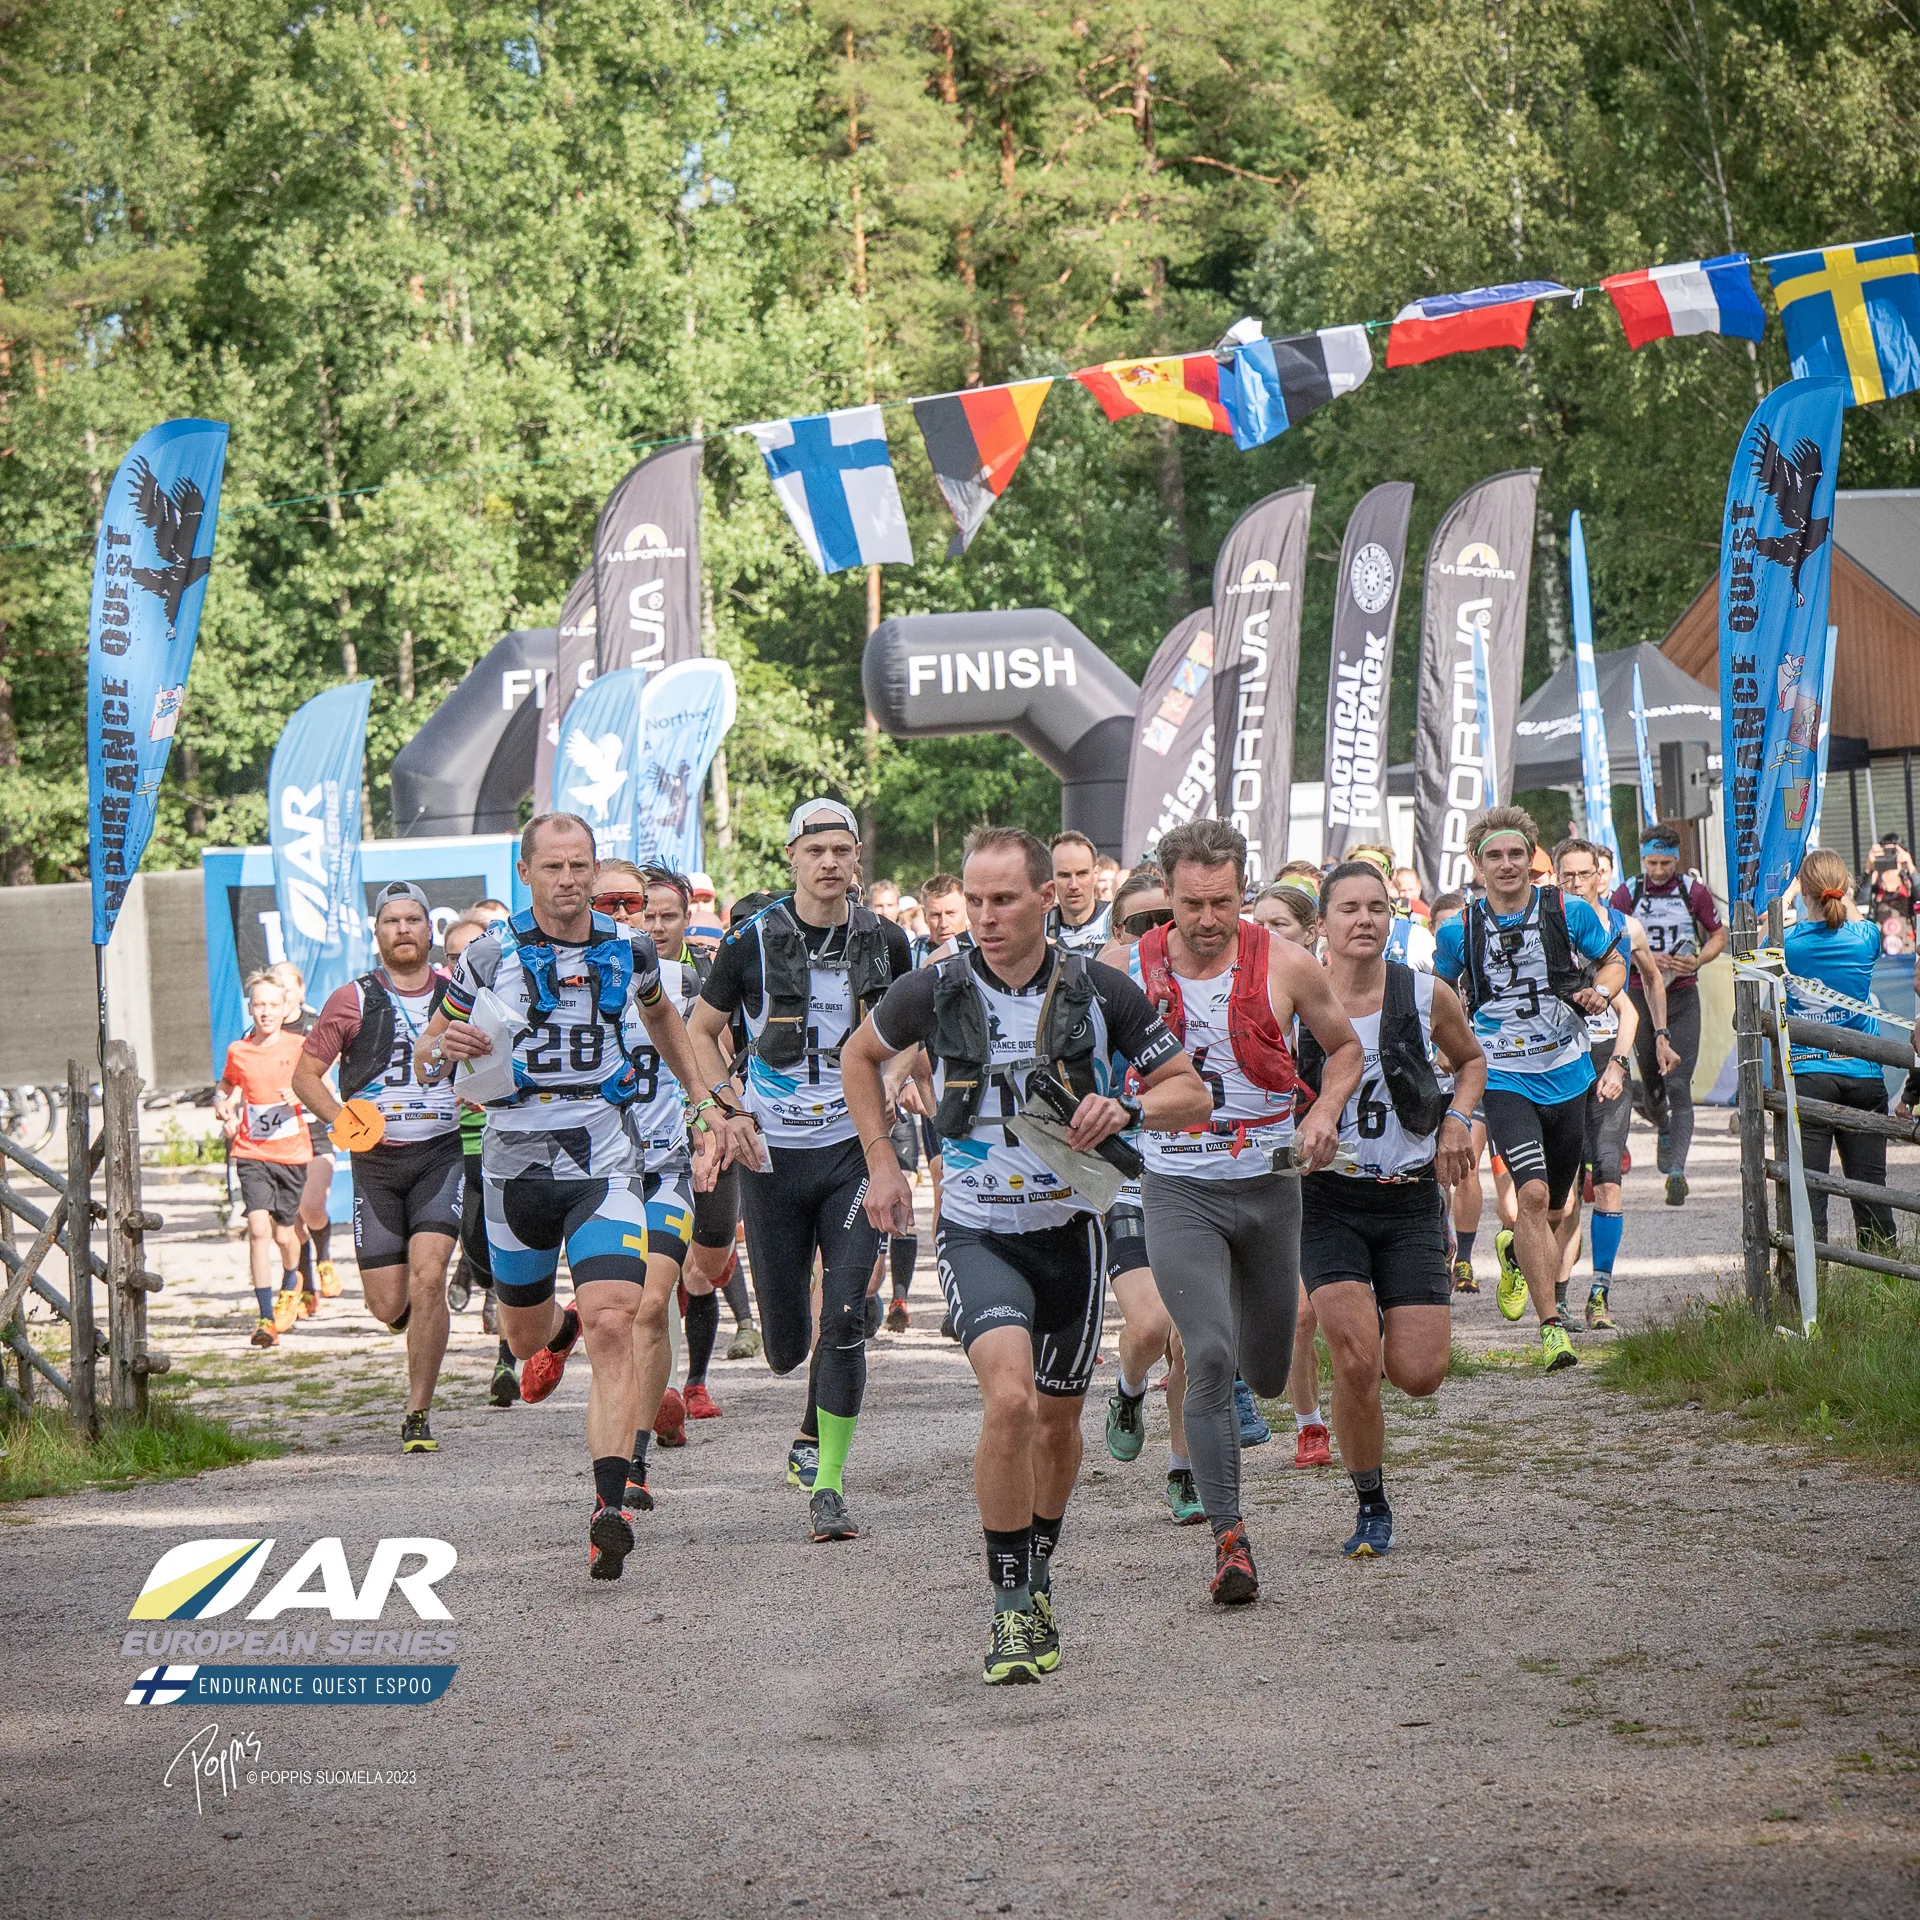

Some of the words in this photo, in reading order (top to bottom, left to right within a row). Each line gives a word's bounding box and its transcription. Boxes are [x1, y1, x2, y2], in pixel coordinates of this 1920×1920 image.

[1728, 500, 1759, 632] QUEST
[100, 525, 132, 657] QUEST
[908, 647, 1078, 696] FINISH
[1328, 659, 1364, 828] TACTICAL
[1350, 631, 1387, 828] FOODPACK
[1731, 653, 1766, 895] NDURANCE
[281, 783, 330, 888] AR
[1648, 926, 1679, 951] 31
[825, 1003, 843, 1011] QUEST
[525, 1023, 605, 1073] 28
[1019, 1040, 1037, 1049] QUES
[1364, 1053, 1380, 1063] UEST
[1792, 1053, 1822, 1061] UMONITE
[259, 1113, 281, 1131] 54
[1356, 1079, 1387, 1139] 6
[1162, 1145, 1201, 1153] LUMONITE
[843, 1177, 870, 1230] noname
[979, 1195, 1022, 1203] LUMONITE
[1035, 1371, 1087, 1390] HALTI
